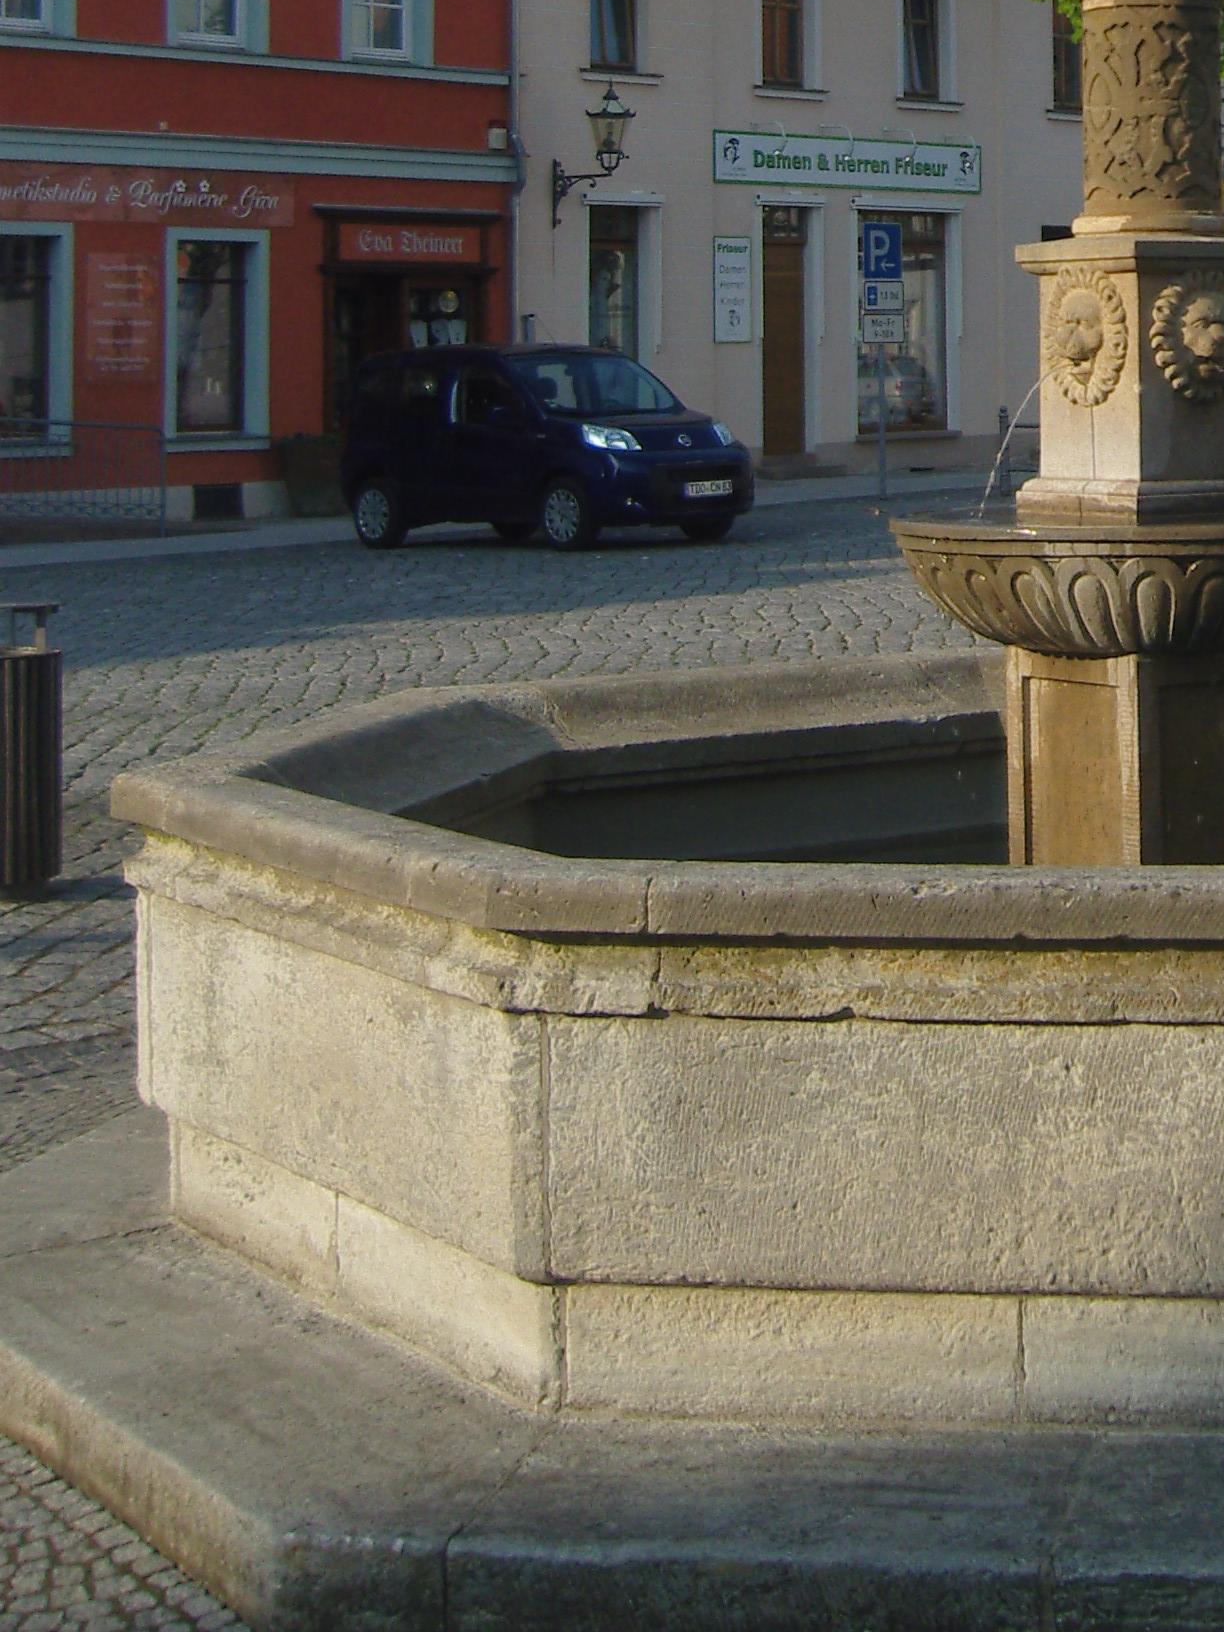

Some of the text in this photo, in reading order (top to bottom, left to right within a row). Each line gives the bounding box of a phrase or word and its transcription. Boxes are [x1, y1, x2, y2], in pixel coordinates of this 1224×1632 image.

[752, 149, 949, 178] Damen & Herren Friseur
[717, 243, 748, 253] Friseur
[869, 230, 890, 272] P
